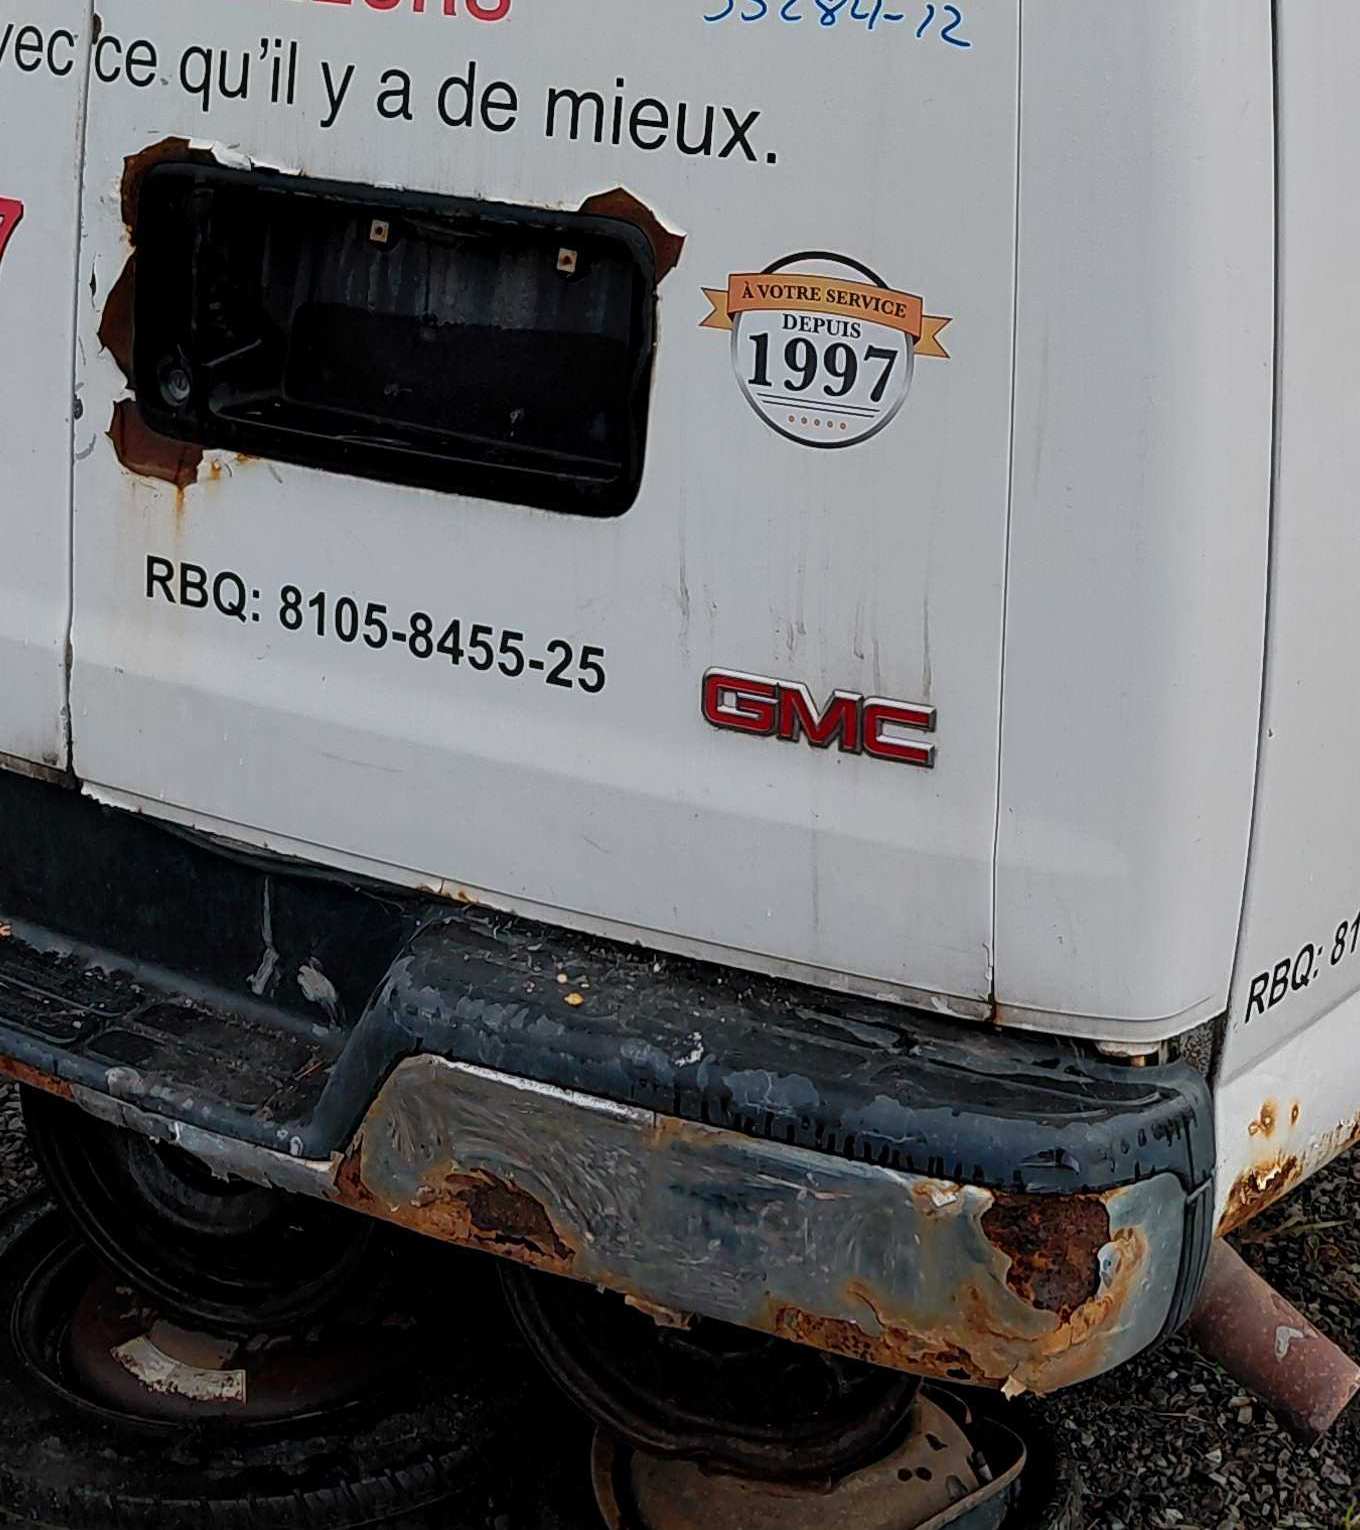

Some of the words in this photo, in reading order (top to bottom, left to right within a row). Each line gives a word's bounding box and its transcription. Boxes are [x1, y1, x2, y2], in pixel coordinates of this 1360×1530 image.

[93, 34, 158, 88] ce
[319, 61, 356, 129] y
[376, 68, 413, 123] a
[437, 61, 518, 133] de
[545, 78, 780, 165] mieux.
[756, 283, 822, 302] VOTRE
[826, 288, 908, 319] SERVICE
[781, 313, 862, 339] DEPUIS
[748, 332, 899, 403] 1997
[146, 554, 262, 624] RBQ:
[278, 585, 608, 695] 8105-8455-25
[700, 665, 938, 769] GMC
[1244, 943, 1324, 1024] RBQ:
